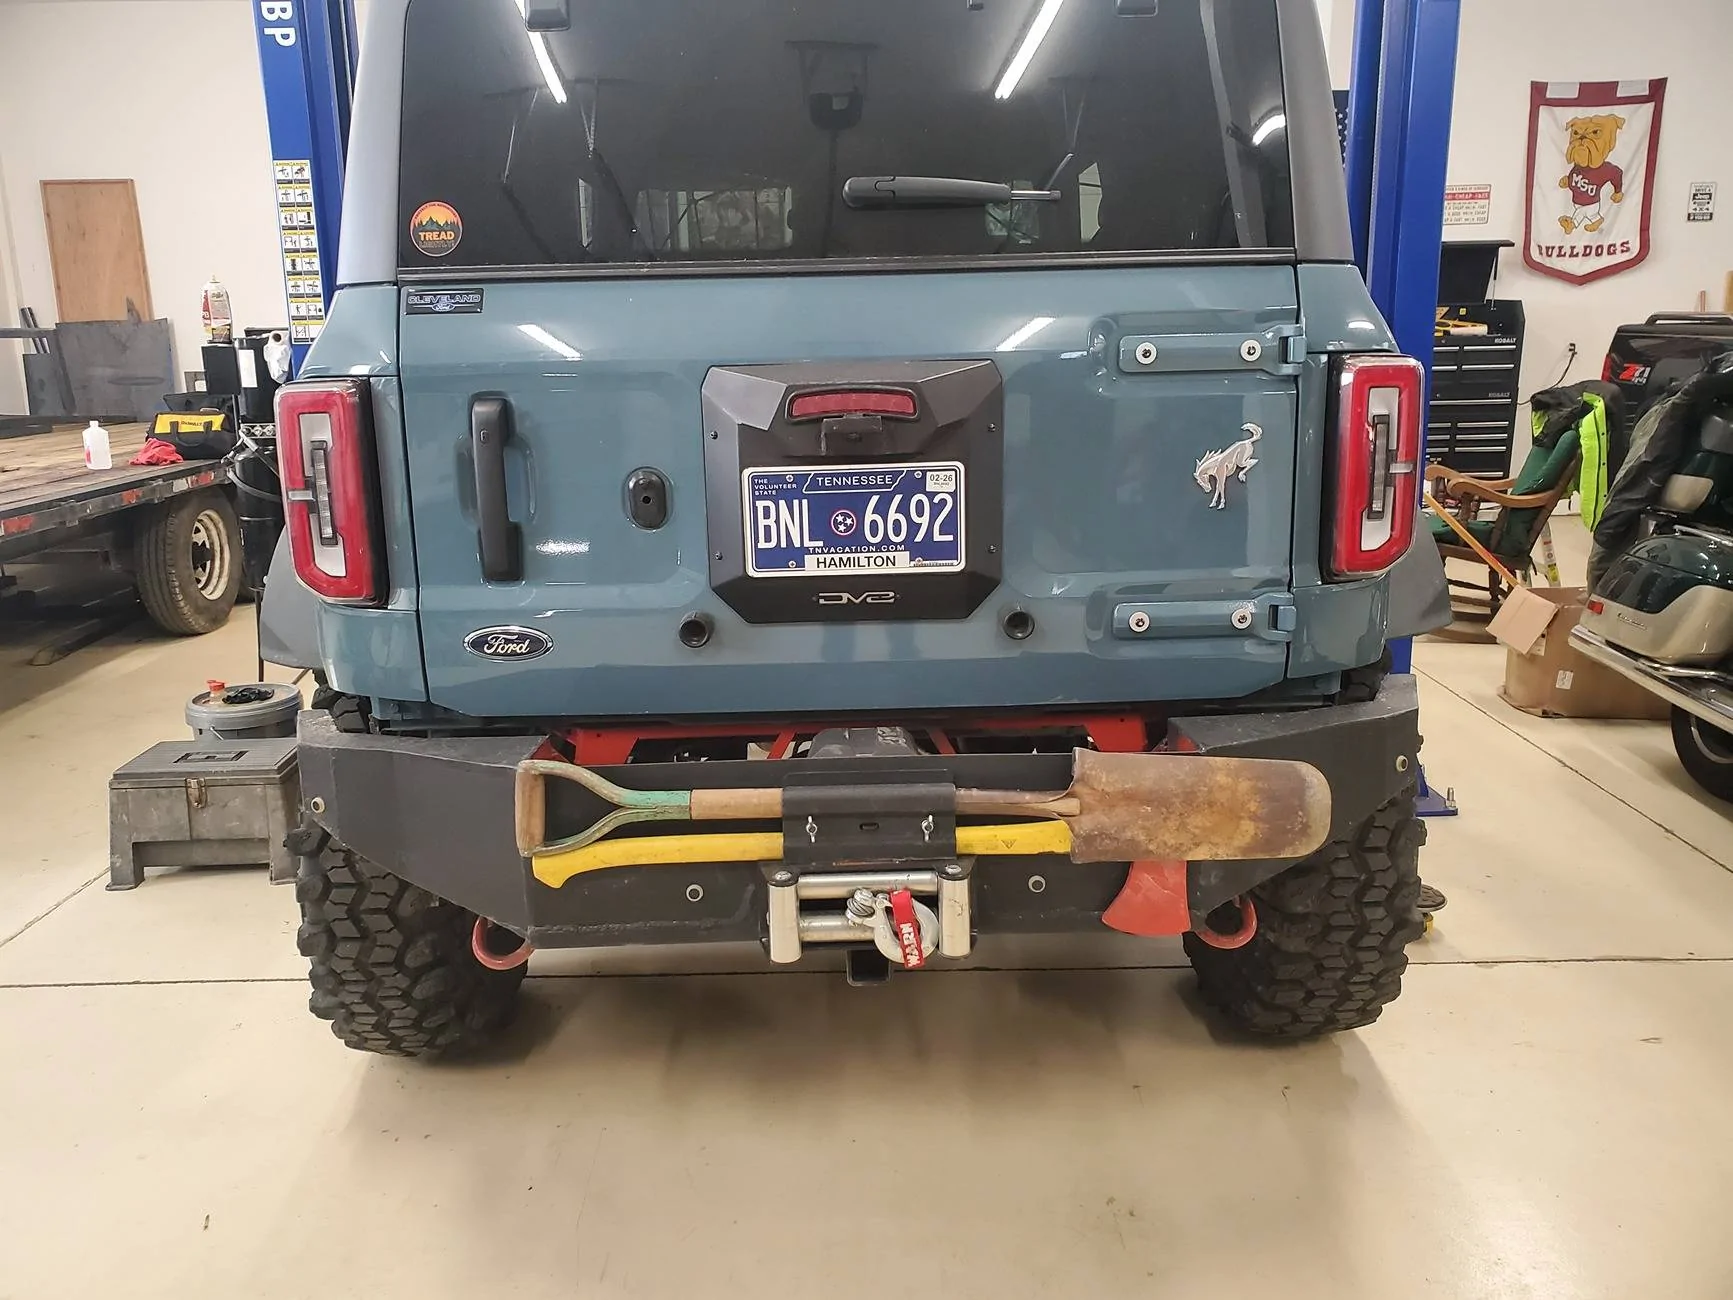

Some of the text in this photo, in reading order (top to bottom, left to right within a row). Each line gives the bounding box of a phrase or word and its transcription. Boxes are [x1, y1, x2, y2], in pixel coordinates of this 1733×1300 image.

[1572, 174, 1597, 196] MSU
[419, 231, 455, 241] TREAD
[408, 294, 481, 304] CLEVELAND
[816, 475, 893, 487] TENNESSEE
[929, 474, 953, 482] 02-26
[756, 493, 954, 549] BNL 6692
[808, 544, 905, 554] TNVACATION.COM
[816, 555, 897, 569] HAMILTON
[483, 634, 531, 654] Ford
[900, 922, 921, 967] WARN
